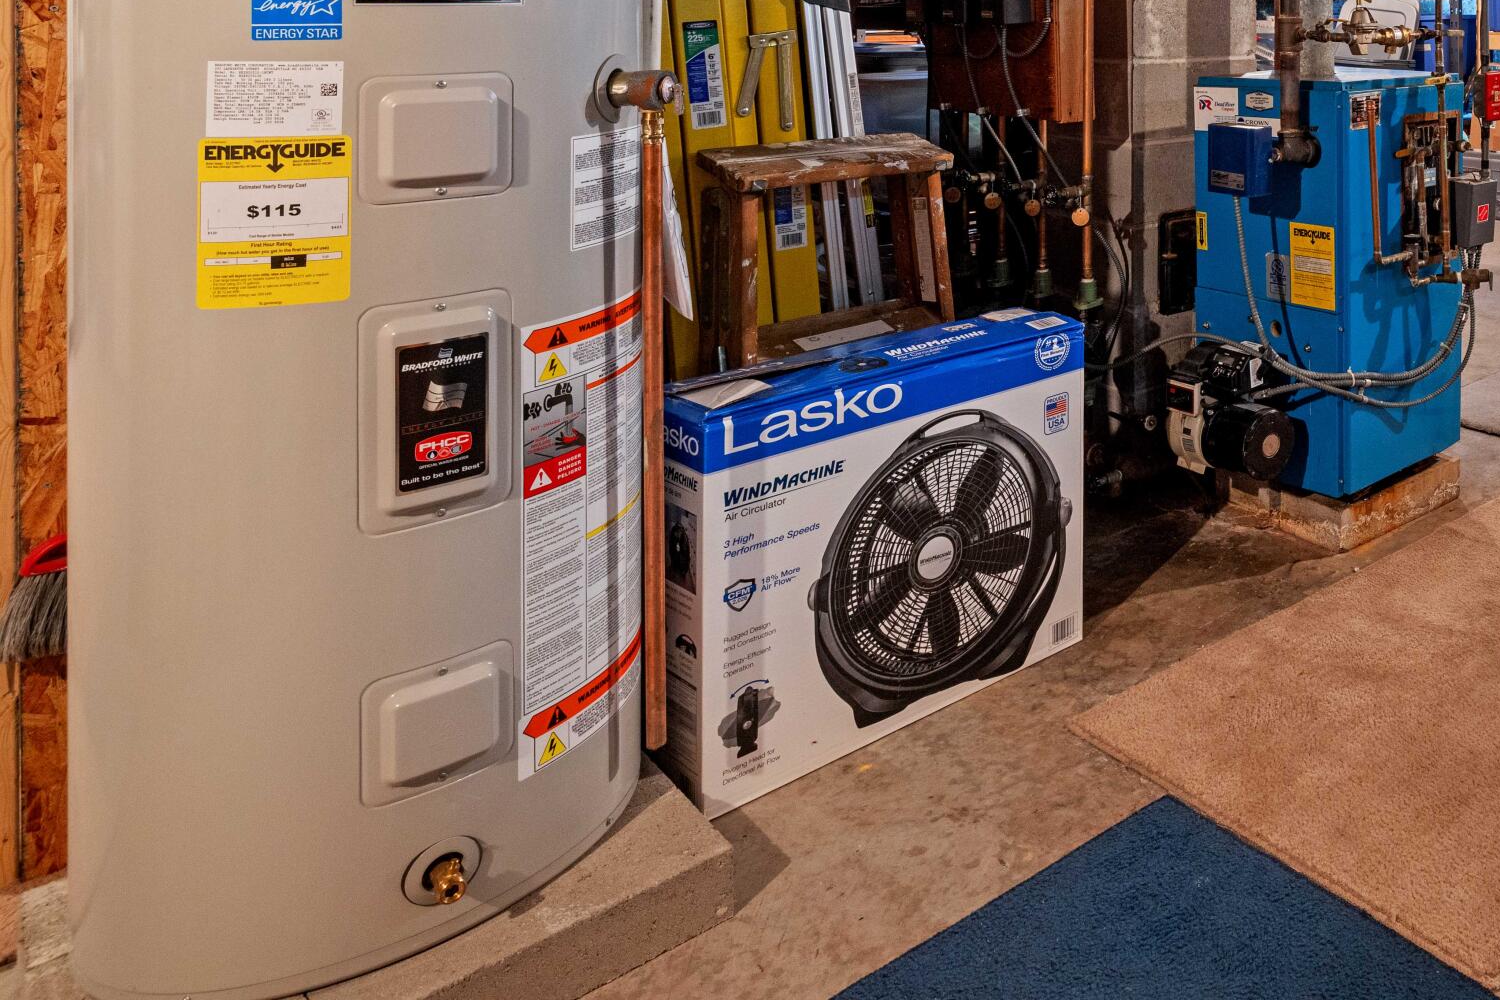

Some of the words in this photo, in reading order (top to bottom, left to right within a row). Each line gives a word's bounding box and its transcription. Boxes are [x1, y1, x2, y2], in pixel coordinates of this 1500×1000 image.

[255, 28, 303, 39] ENERGY
[306, 28, 338, 39] STAR
[687, 34, 703, 43] 225
[277, 182, 294, 190] Energy
[247, 203, 301, 220] $115
[1045, 337, 1060, 350] #1
[401, 358, 453, 373] BRADFORD
[454, 351, 484, 363] WHITE
[1047, 394, 1067, 404] PROUDLY
[723, 383, 904, 455] Lasko
[1048, 418, 1065, 429] USA
[419, 434, 469, 452] PHCC
[664, 425, 699, 456] asko
[558, 453, 582, 466] DANGER
[558, 459, 582, 473] DANGER
[401, 475, 420, 486] Built
[422, 473, 431, 481] to
[432, 471, 444, 479] be
[446, 468, 460, 476] the
[557, 466, 582, 480] PELIGRO
[724, 460, 845, 507] WINDMACHINE
[724, 510, 738, 522] Air
[740, 497, 786, 518] Circulator
[723, 540, 730, 549] 3
[732, 532, 755, 547] High
[724, 534, 785, 560] Performance
[787, 522, 820, 539] Speeds
[761, 574, 779, 585] 18%
[781, 566, 801, 579] More
[728, 585, 752, 600] CFM
[760, 584, 772, 593] Air
[723, 629, 749, 645] Rugged
[749, 622, 771, 635] Design
[723, 644, 736, 653] and
[736, 629, 777, 648] Construction
[723, 646, 772, 670] Energy-Efficient
[723, 662, 754, 679] Operation
[722, 759, 748, 776] Pivoting
[748, 753, 766, 765] Head
[767, 748, 775, 757] for
[722, 767, 756, 786] Directional
[756, 762, 765, 771] Air
[766, 755, 781, 765] Flow
